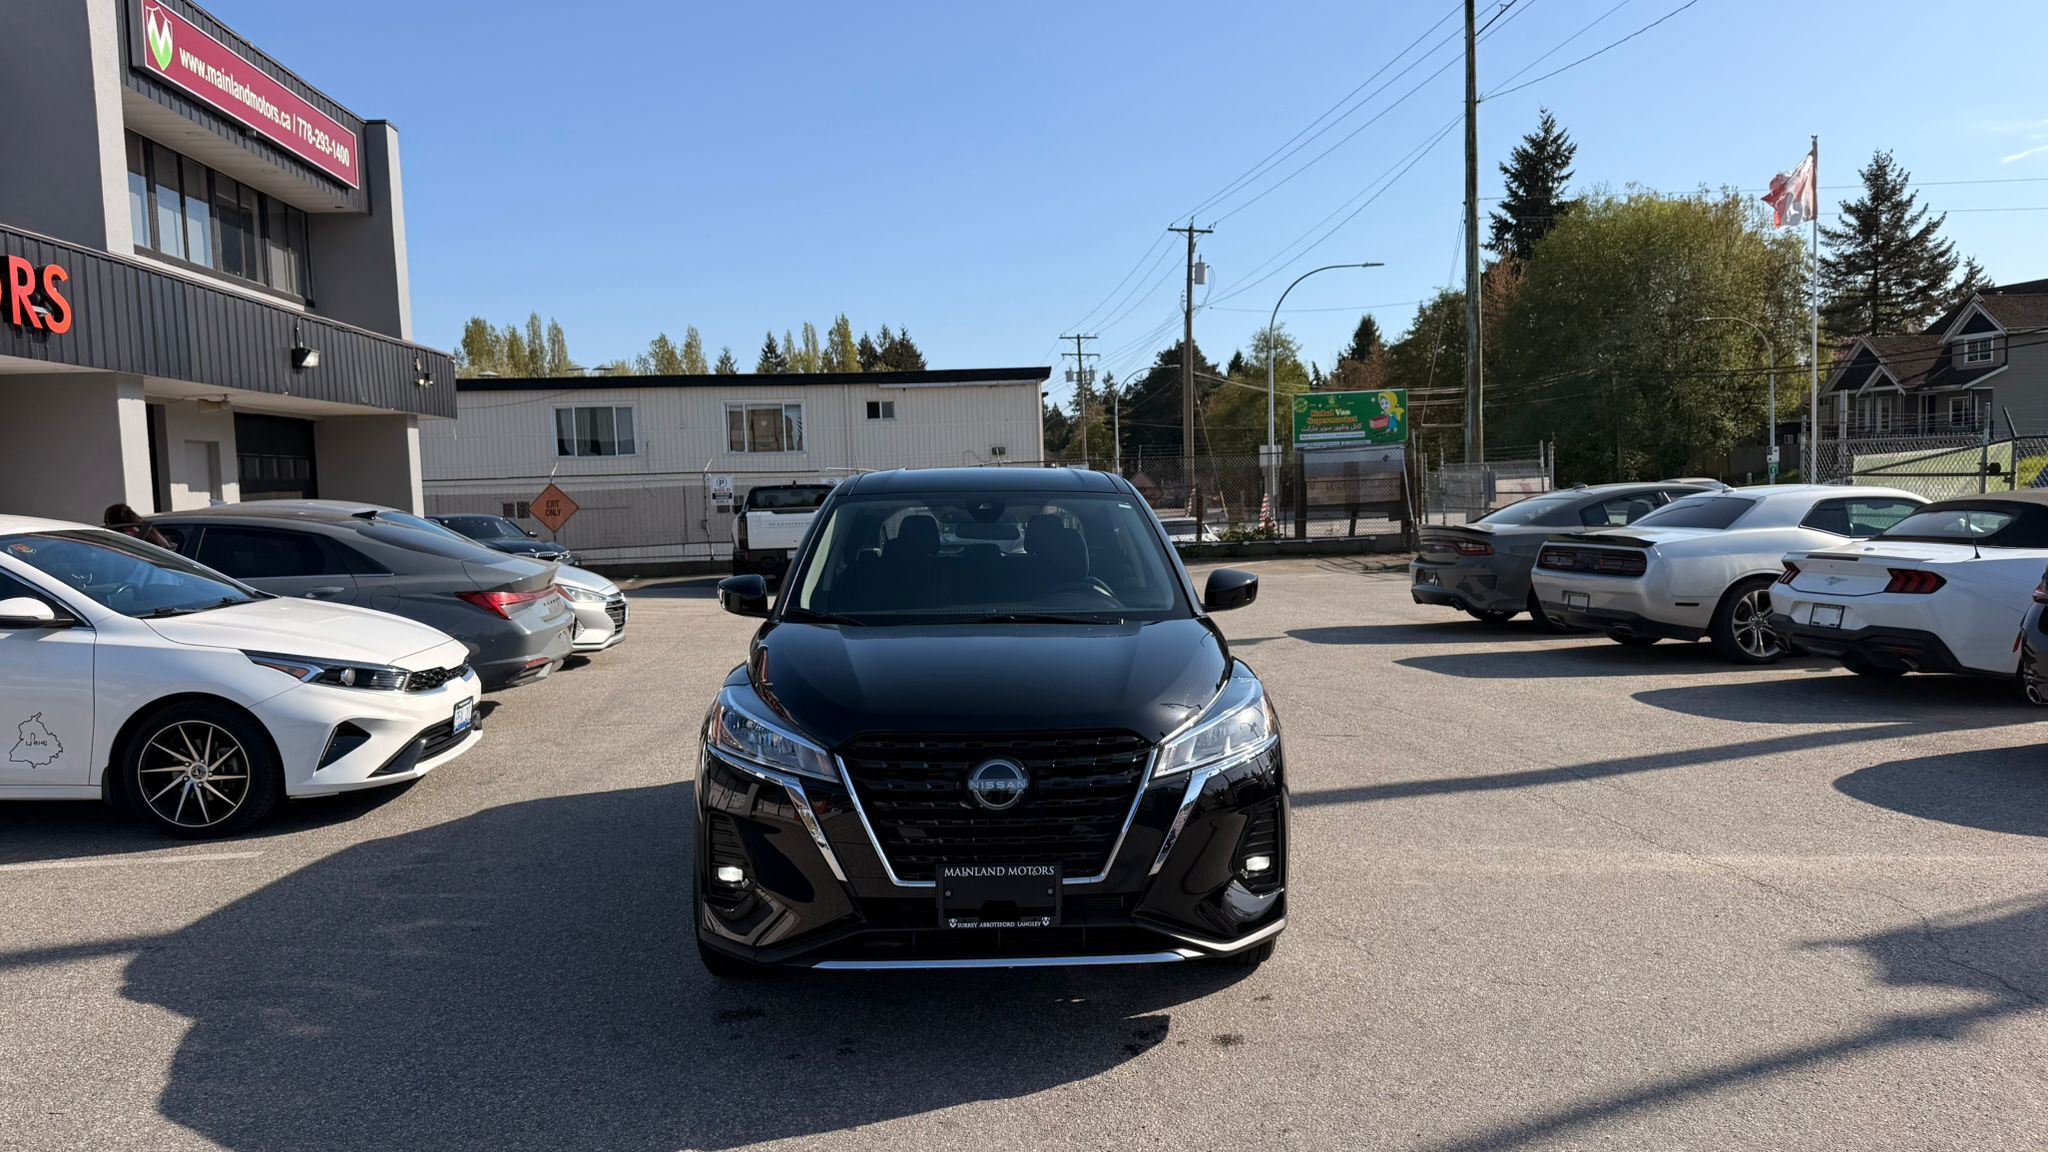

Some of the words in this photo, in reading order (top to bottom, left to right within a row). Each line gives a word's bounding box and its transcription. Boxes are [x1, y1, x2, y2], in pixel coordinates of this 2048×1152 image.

[179, 47, 292, 131] www.mainlandmotors.ca
[296, 116, 350, 167] 778-293-1400
[0, 255, 72, 334] RS
[546, 500, 559, 508] EXIT
[545, 509, 561, 517] ONLY
[969, 780, 1027, 790] NISSAN
[944, 866, 1005, 877] MAINLAND
[1008, 866, 1055, 876] MOTORS
